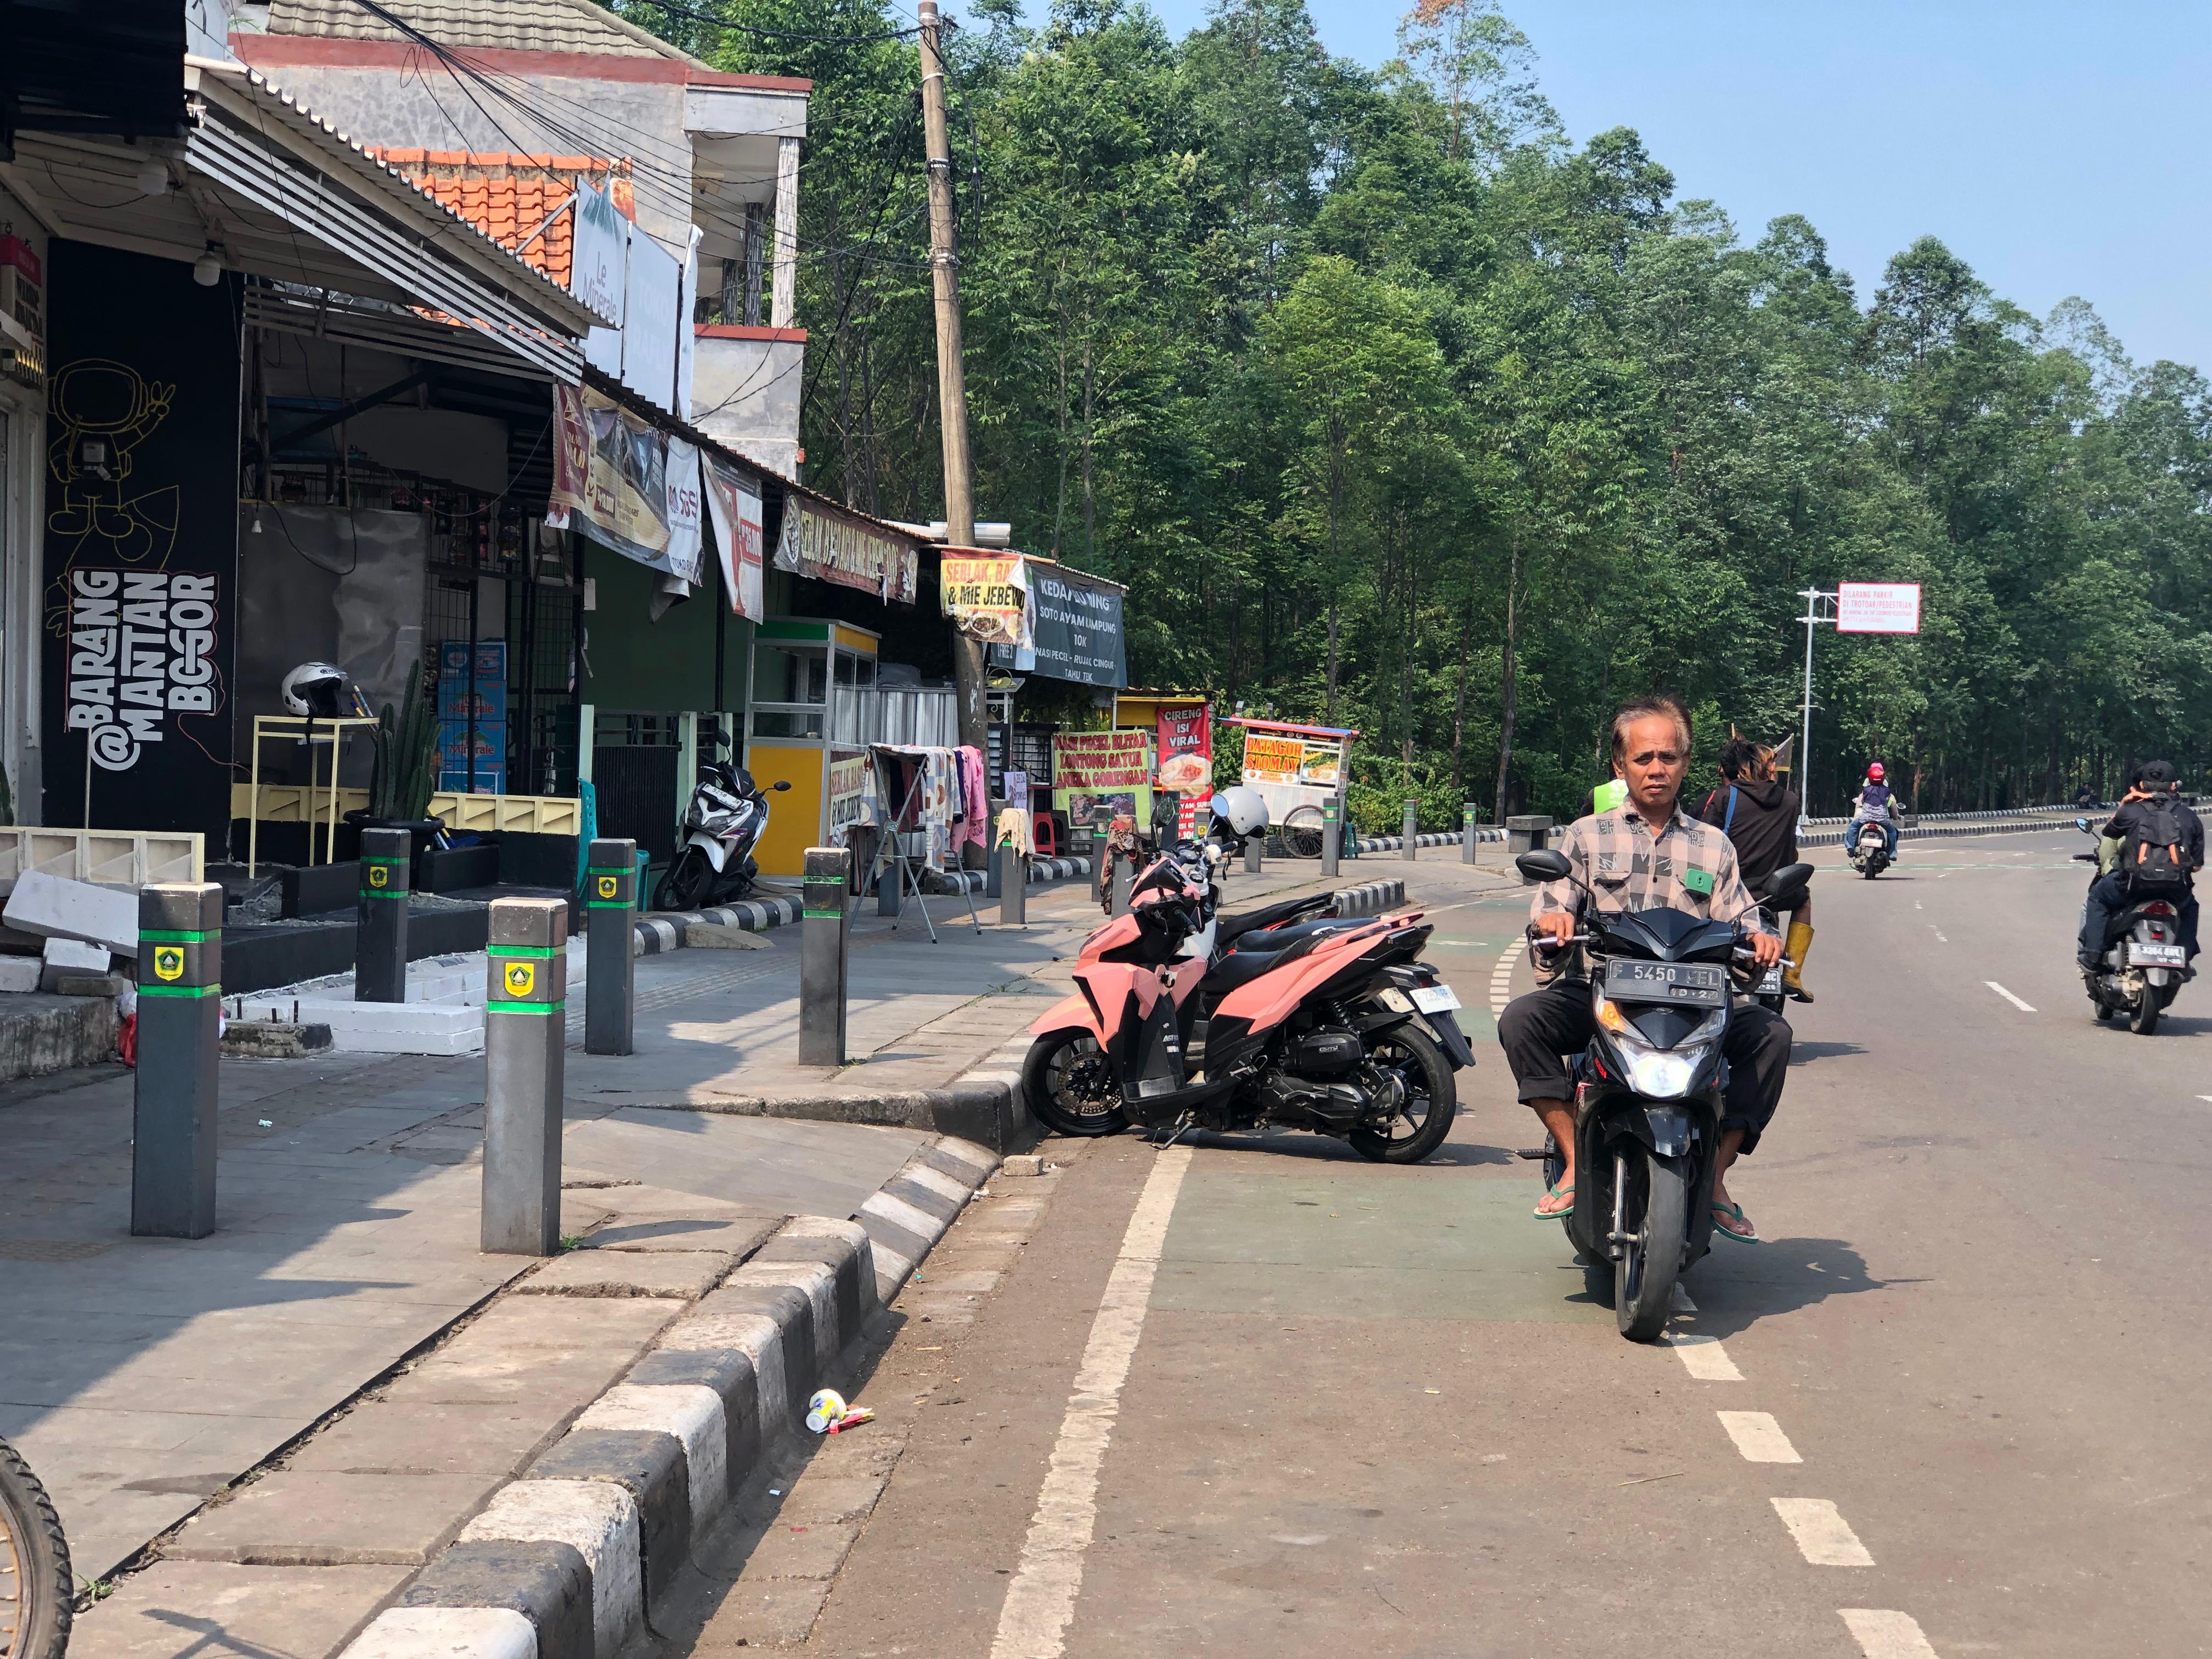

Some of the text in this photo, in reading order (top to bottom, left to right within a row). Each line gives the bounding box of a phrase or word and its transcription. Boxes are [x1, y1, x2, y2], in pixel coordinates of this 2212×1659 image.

[597, 251, 607, 288] Le
[583, 273, 617, 320] Minerale
[997, 563, 1011, 583] BA
[948, 586, 956, 604] &
[961, 585, 980, 605] MIE
[1040, 606, 1116, 634] SOTO AYAM KAMPUNG
[70, 570, 119, 729] BARANG
[1074, 634, 1087, 647] 10K
[1035, 647, 1052, 659] NASI
[1052, 650, 1069, 662] PECEL
[1074, 656, 1092, 667] RUJAK
[1065, 670, 1093, 681] TAHU TEK
[1164, 708, 1201, 721] CIRENG
[1176, 723, 1189, 733] ISI
[449, 744, 494, 754] Minrale
[1054, 732, 1147, 751] NASI PECEL BLITAR
[1169, 734, 1200, 747] VIRAL
[1247, 737, 1304, 758] BATAGOR
[1060, 751, 1142, 769] LONTONG SAYUR
[1245, 754, 1300, 773] SIOMAY
[1056, 769, 1148, 787] ANEKA GORENGAN
[1634, 965, 1676, 981] 5450
